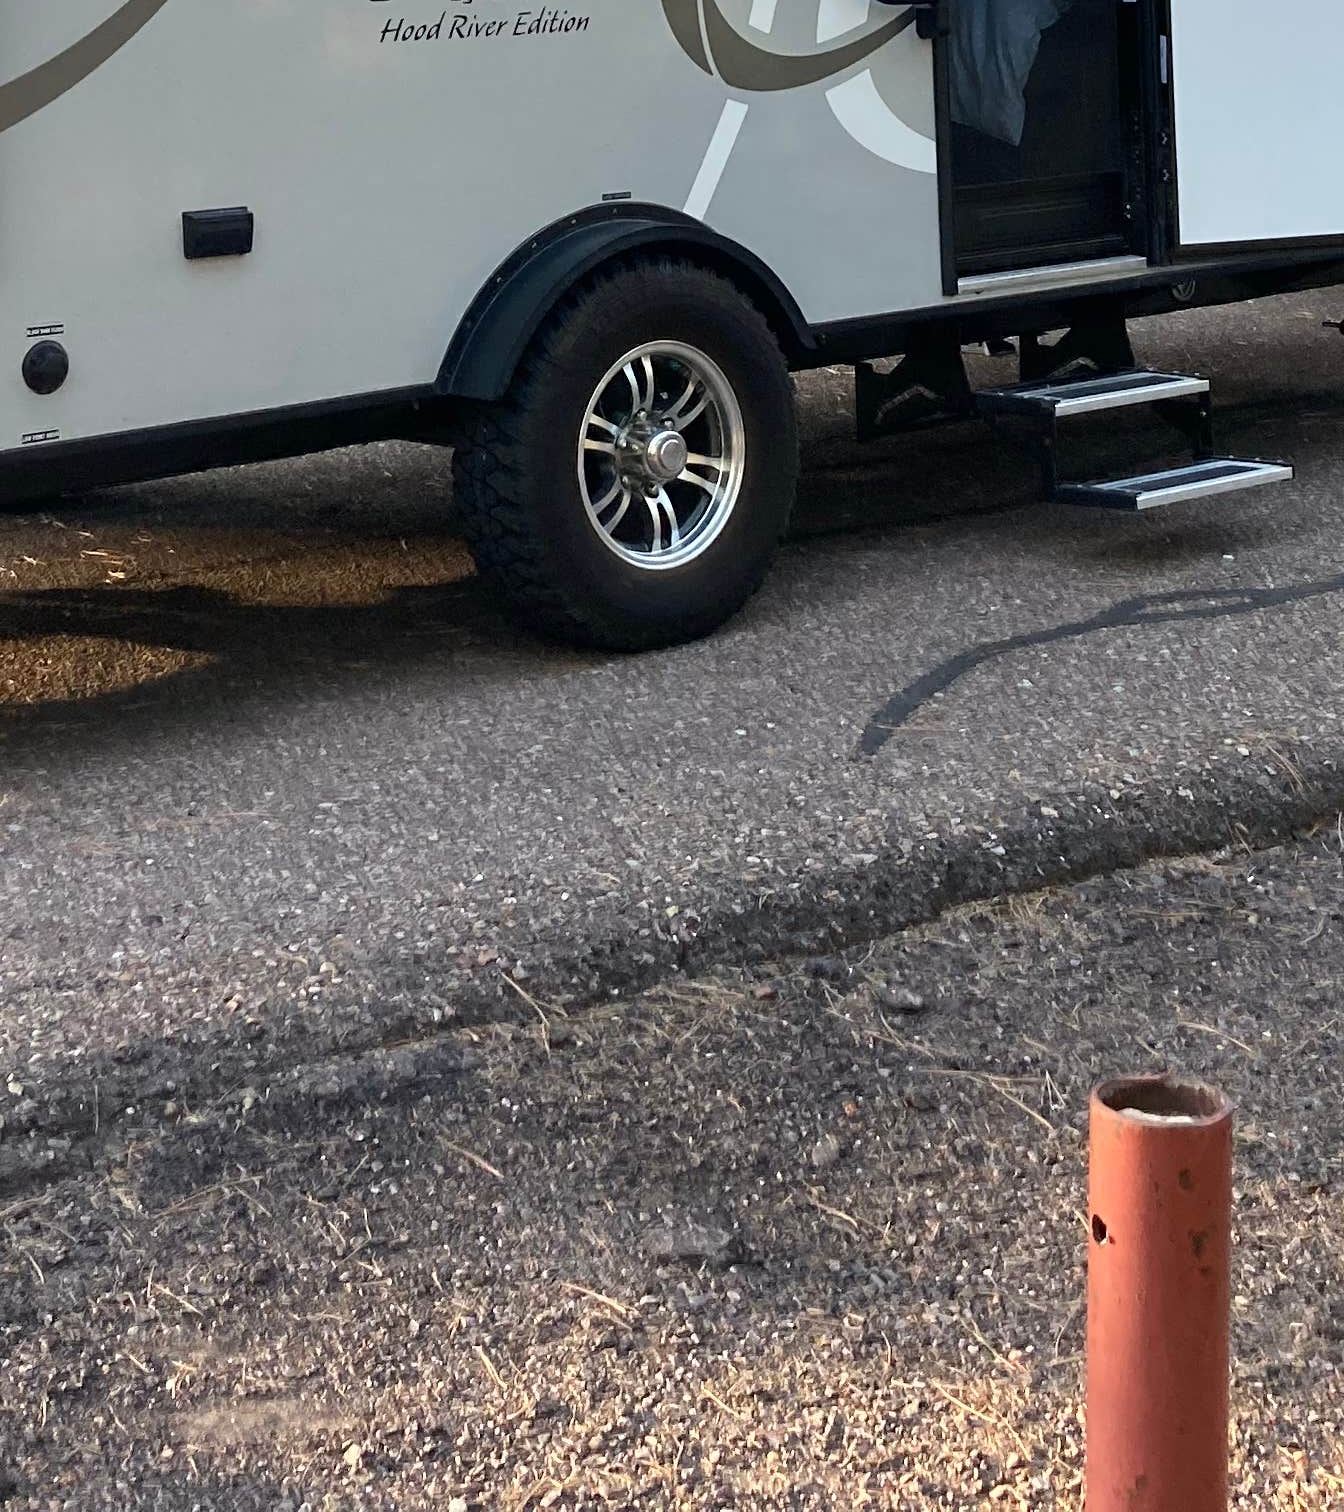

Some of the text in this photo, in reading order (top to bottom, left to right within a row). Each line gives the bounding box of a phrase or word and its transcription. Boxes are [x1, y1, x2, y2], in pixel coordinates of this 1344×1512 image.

[379, 5, 591, 43] Hood River Edition
